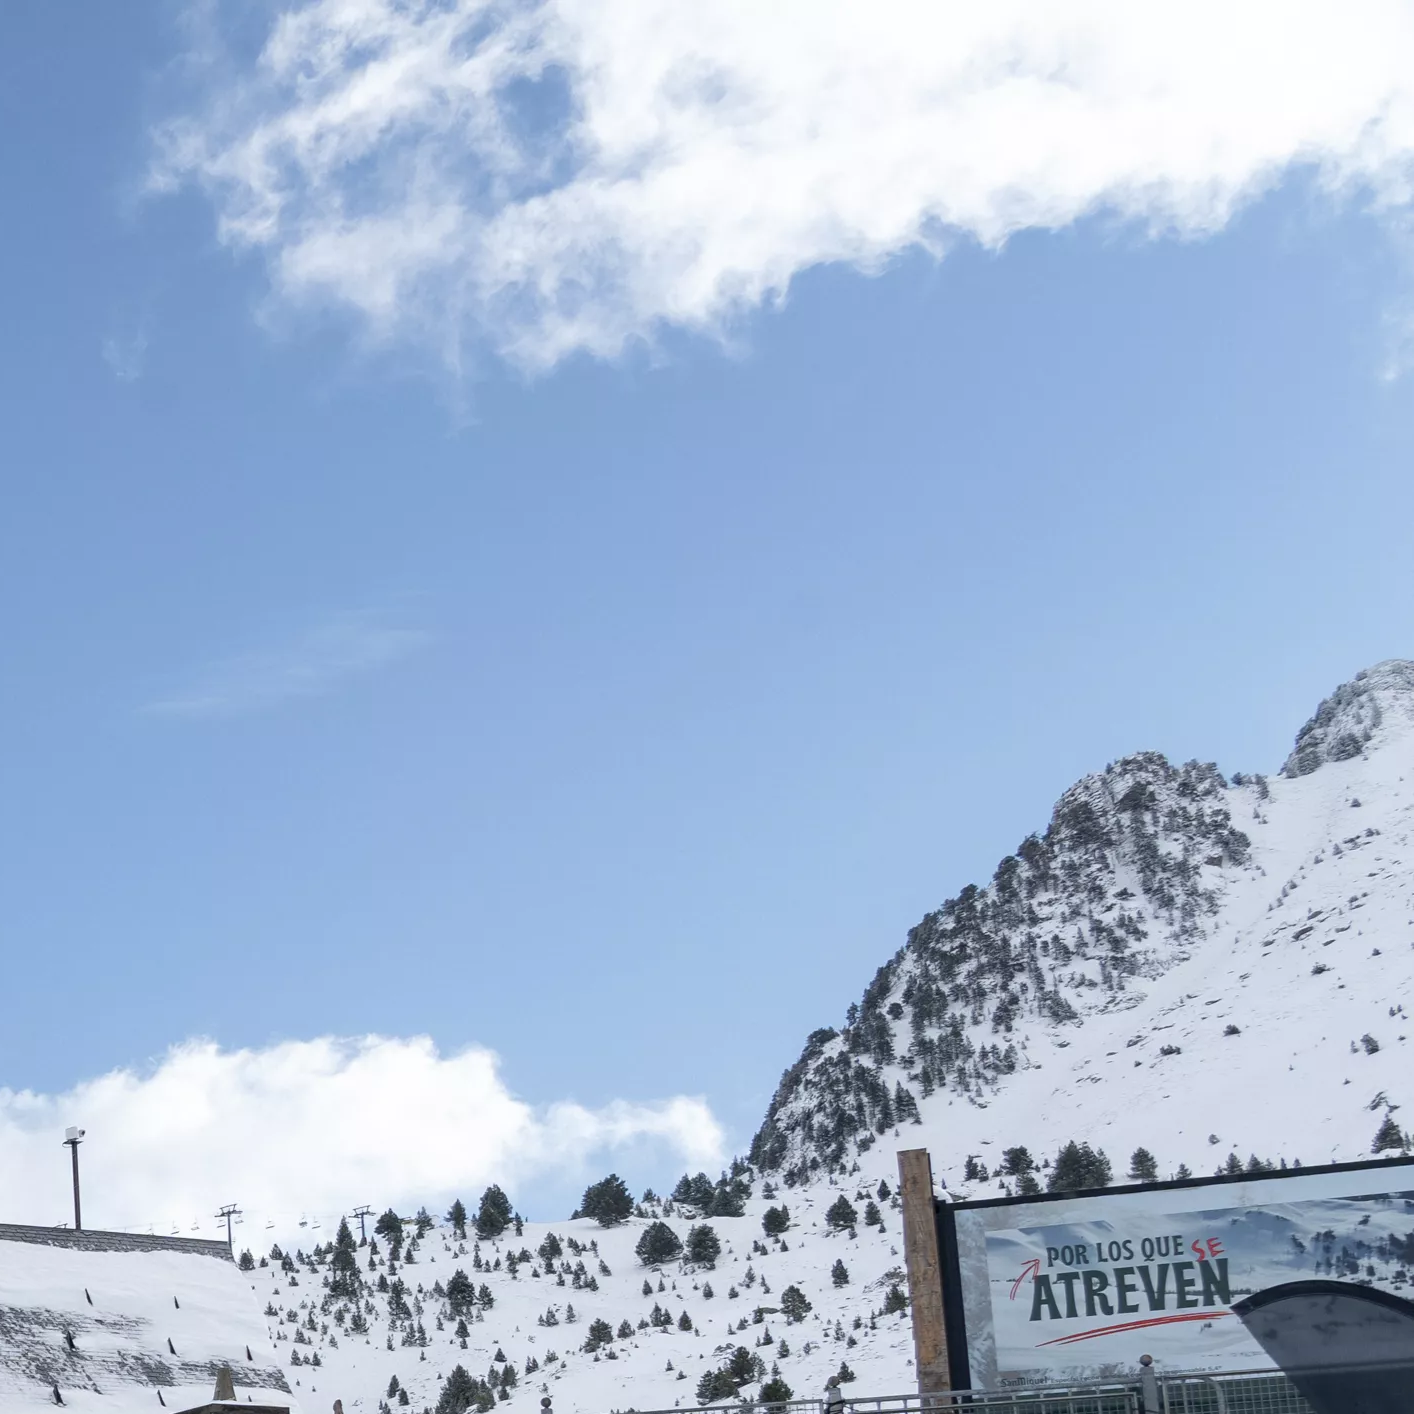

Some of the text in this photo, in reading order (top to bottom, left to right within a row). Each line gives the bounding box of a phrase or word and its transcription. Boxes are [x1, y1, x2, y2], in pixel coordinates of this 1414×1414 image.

[1046, 1235, 1225, 1267] POR LOS QUE SE
[1029, 1258, 1231, 1321] ATREVEN
